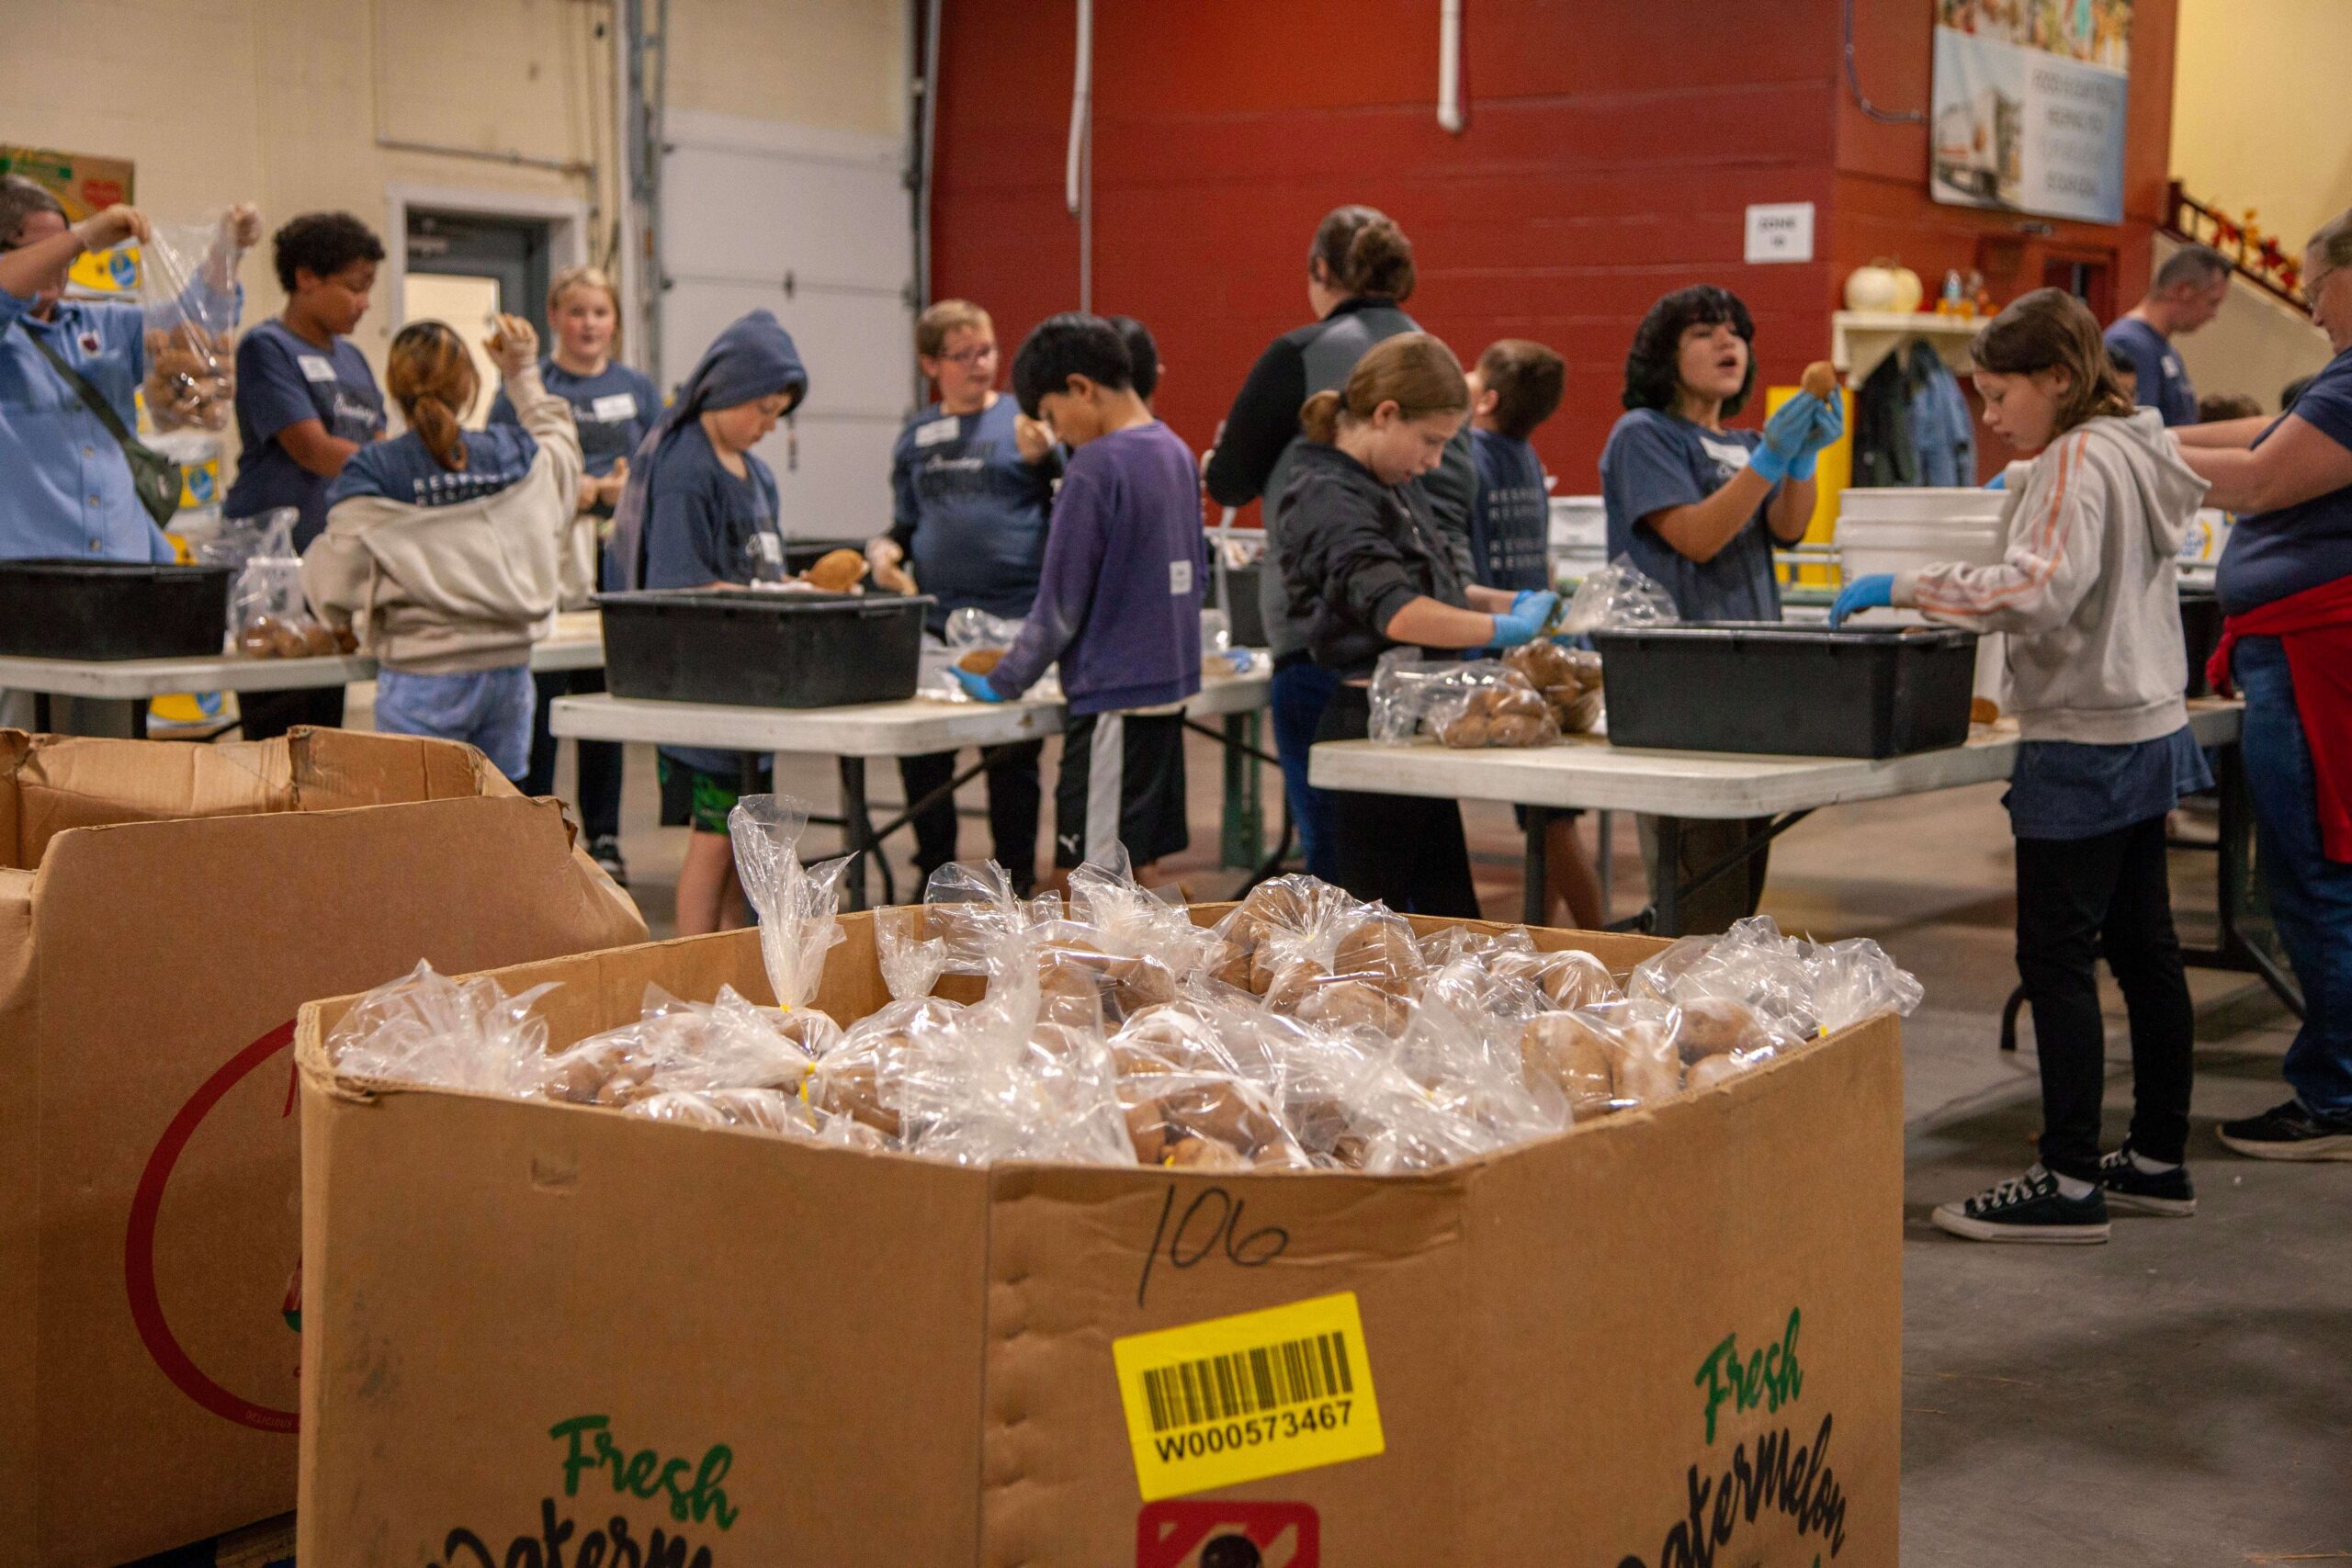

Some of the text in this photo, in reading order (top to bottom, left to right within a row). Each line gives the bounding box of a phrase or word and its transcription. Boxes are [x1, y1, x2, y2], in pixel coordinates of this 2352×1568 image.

[1137, 1183, 1289, 1308] 106
[1155, 1400, 1354, 1464] W000573467
[1694, 1306, 1804, 1448] Fresh
[548, 1414, 740, 1531] Fresh
[1614, 1412, 1847, 1568] atermelon
